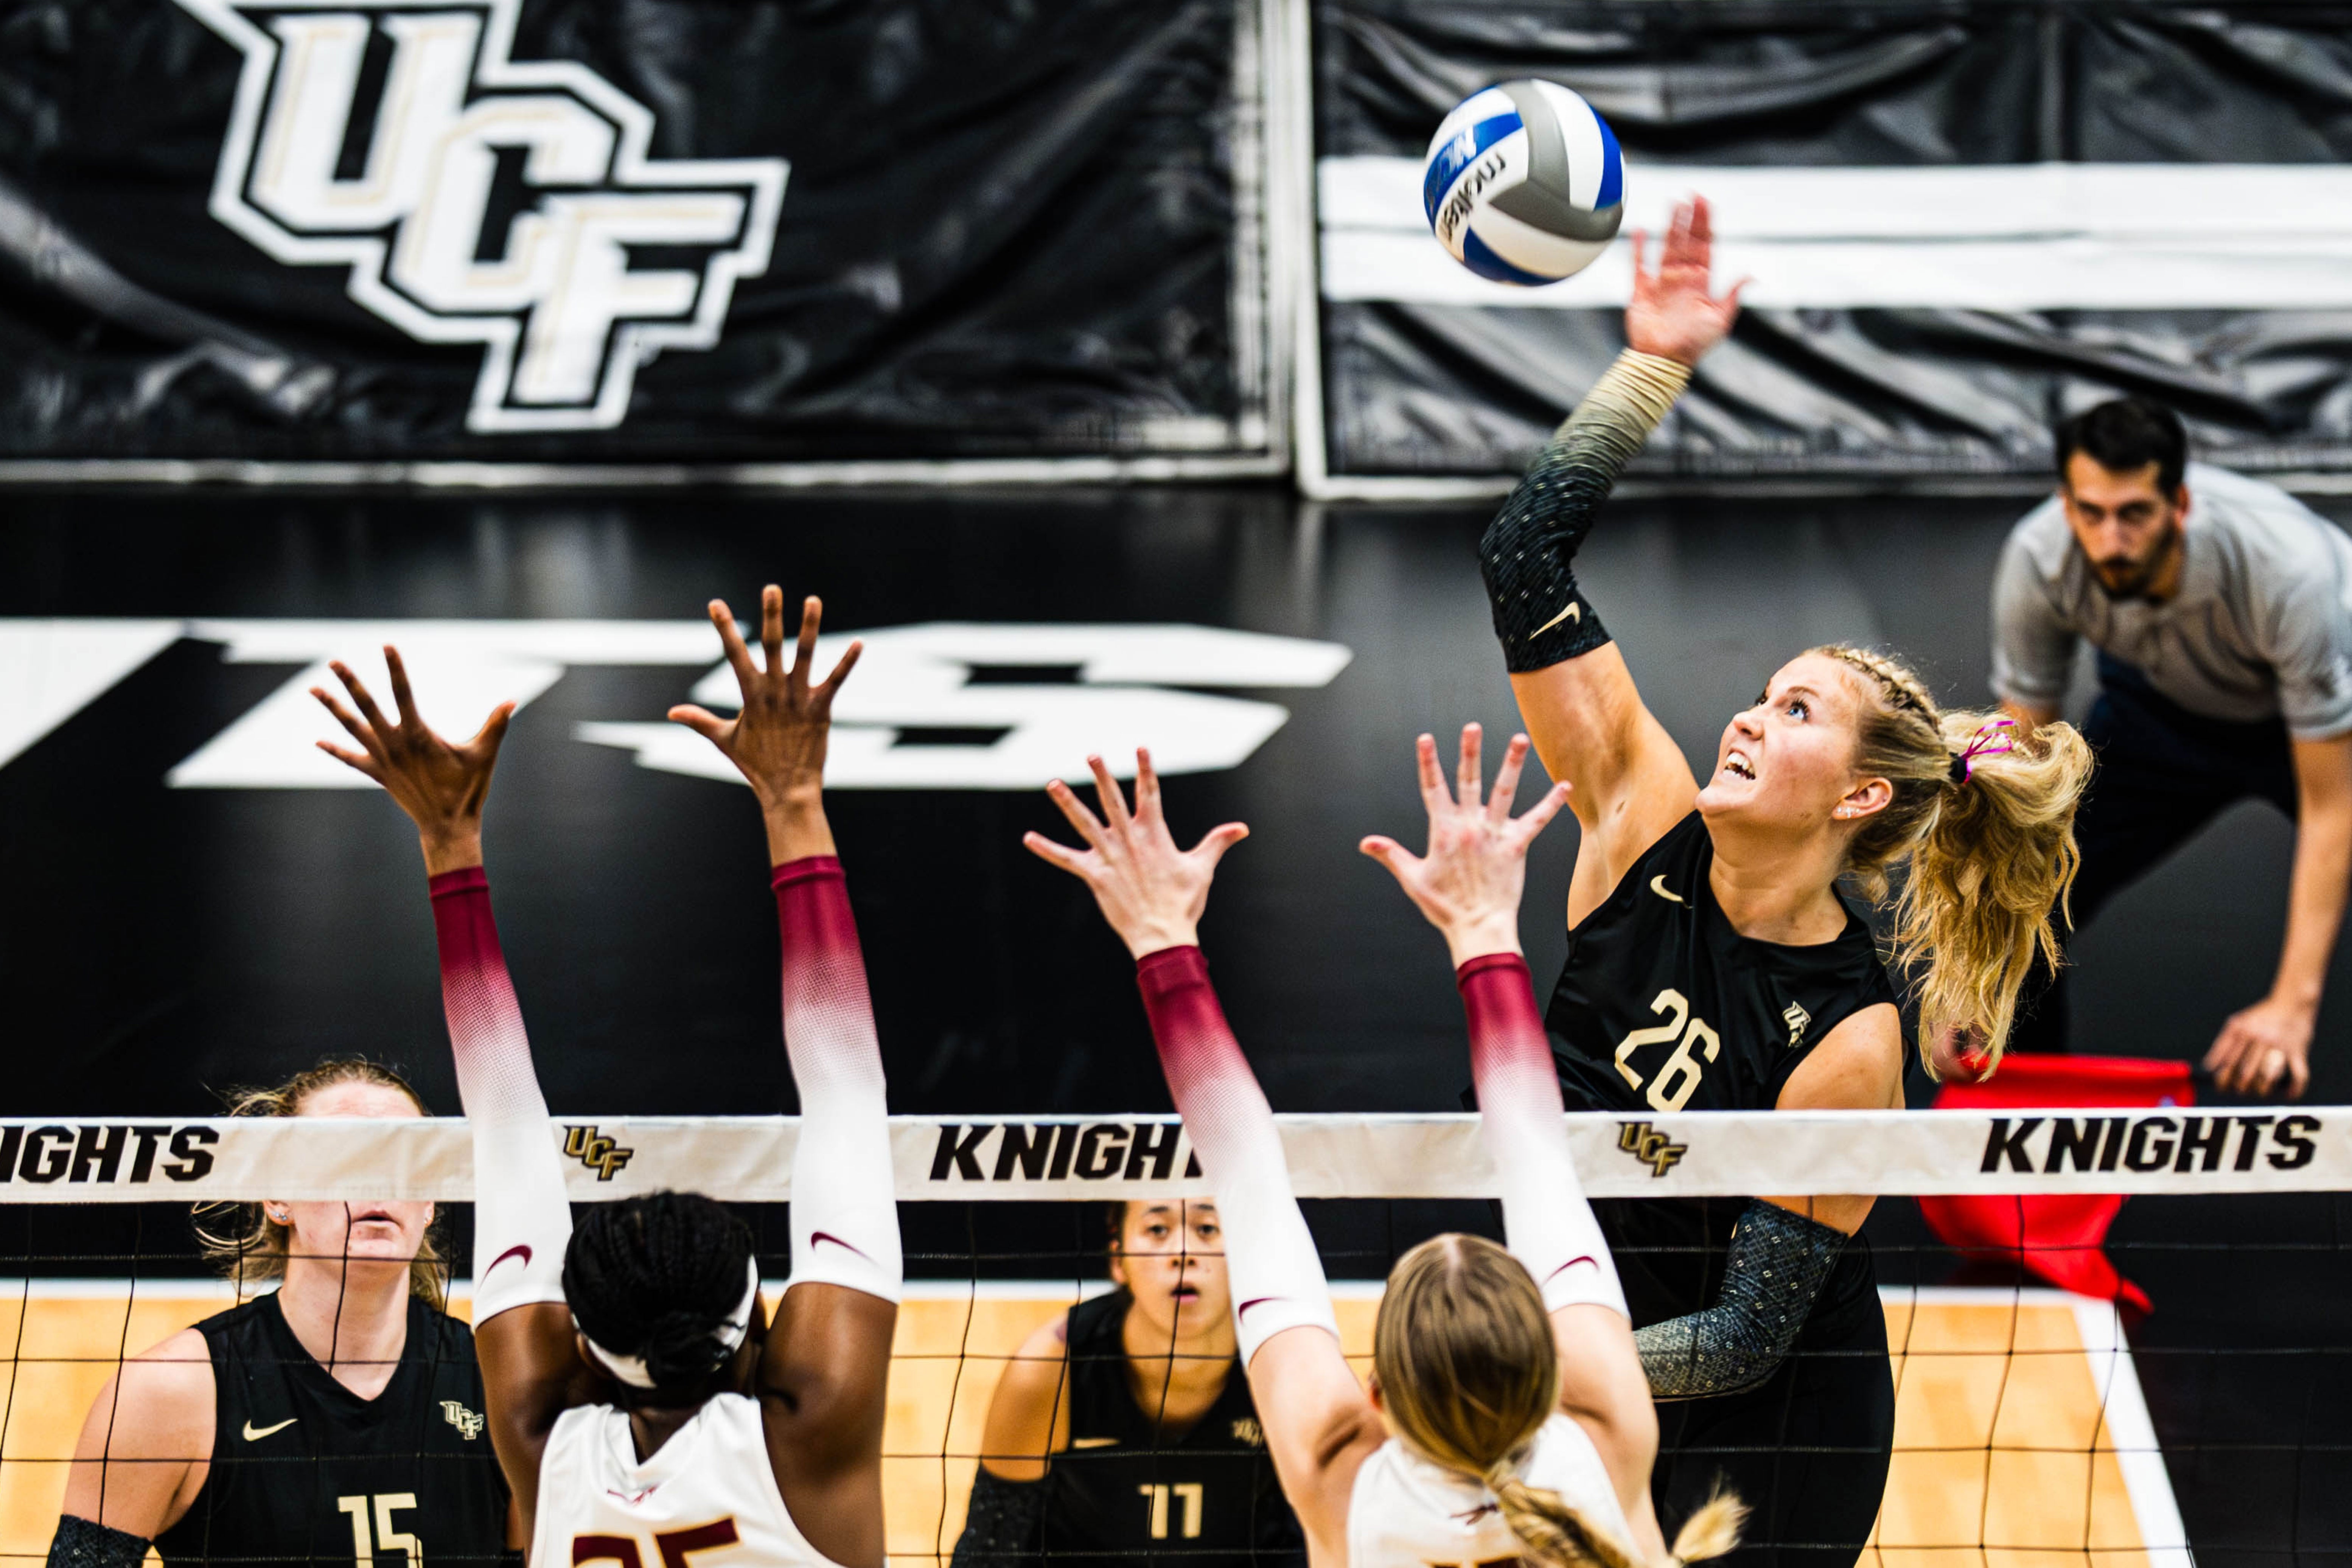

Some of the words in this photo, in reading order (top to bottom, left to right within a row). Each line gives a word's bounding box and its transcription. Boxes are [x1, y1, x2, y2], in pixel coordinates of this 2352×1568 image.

[208, 0, 791, 432] UCF
[0, 617, 1354, 789] TS
[1614, 988, 1721, 1112] 26
[563, 1125, 634, 1181] UCF
[1616, 1121, 1689, 1177] UCF
[1980, 1115, 2322, 1173] KNIGHTS
[439, 1400, 484, 1440] UCF
[337, 1492, 423, 1568] 15
[1138, 1483, 1203, 1539] 11
